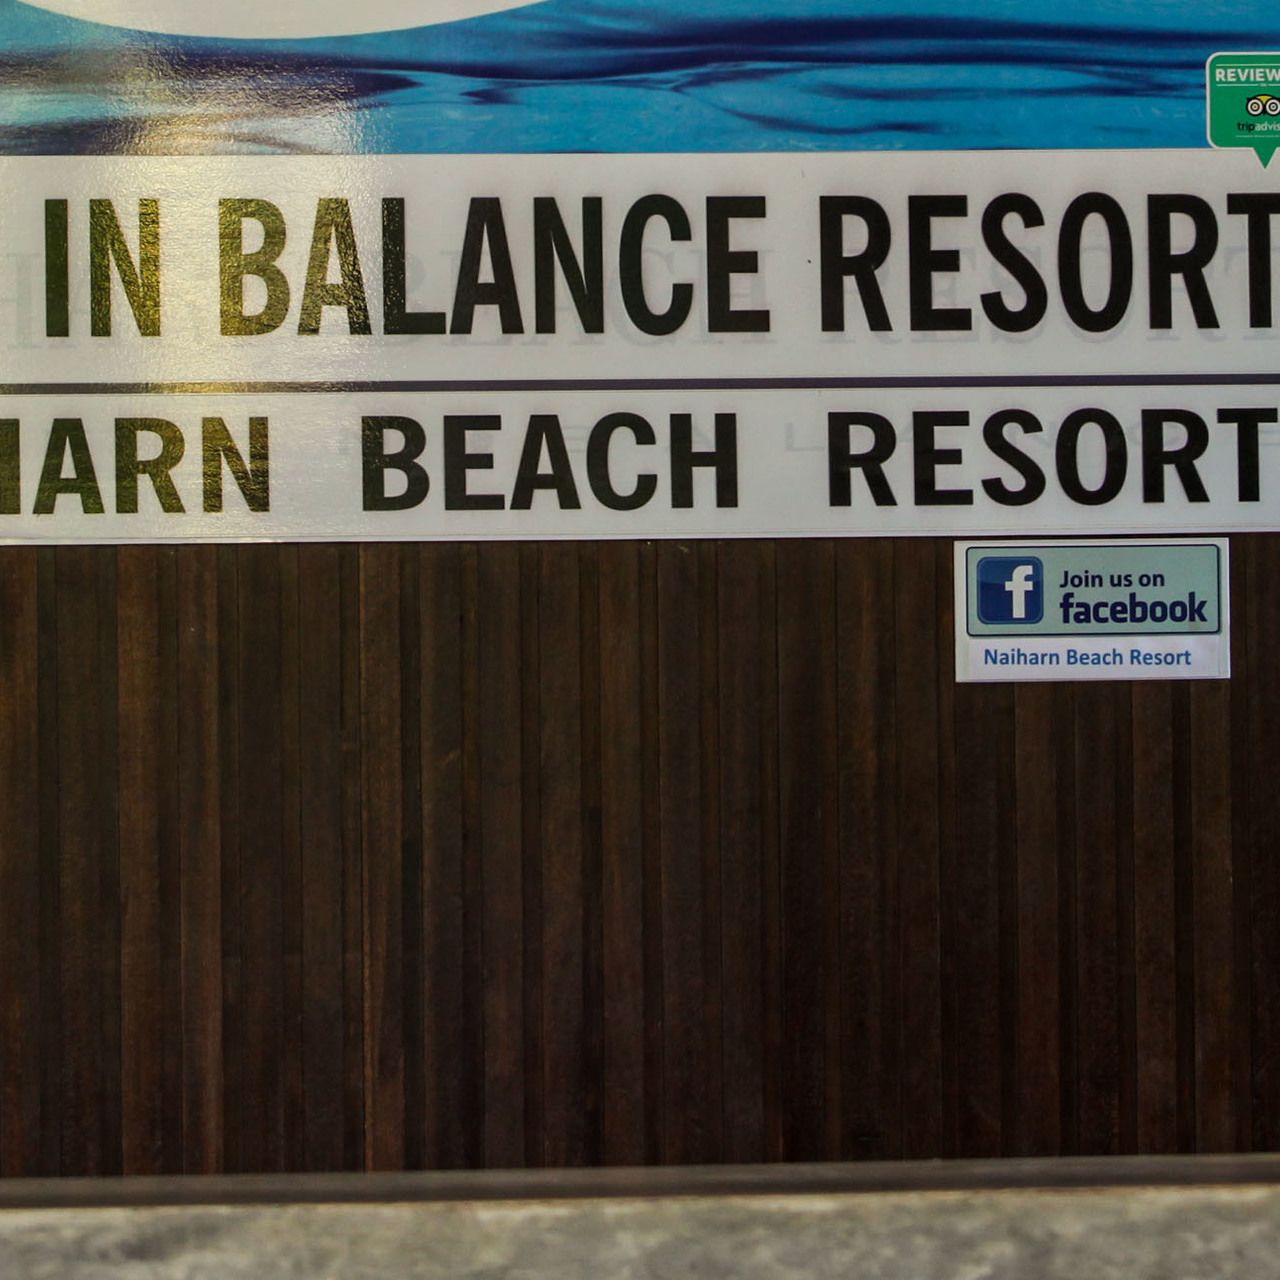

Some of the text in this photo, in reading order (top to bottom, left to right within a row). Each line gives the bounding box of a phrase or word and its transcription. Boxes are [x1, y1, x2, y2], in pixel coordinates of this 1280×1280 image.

[45, 198, 162, 339] IN
[218, 194, 771, 338] BALANCE
[361, 412, 739, 513] BEACH
[828, 407, 1278, 508] RESORT
[1005, 565, 1033, 618] f
[1059, 570, 1165, 588] Join us on
[1059, 592, 1208, 624] facebook
[984, 648, 1191, 666] Naiharn Beach Resort
